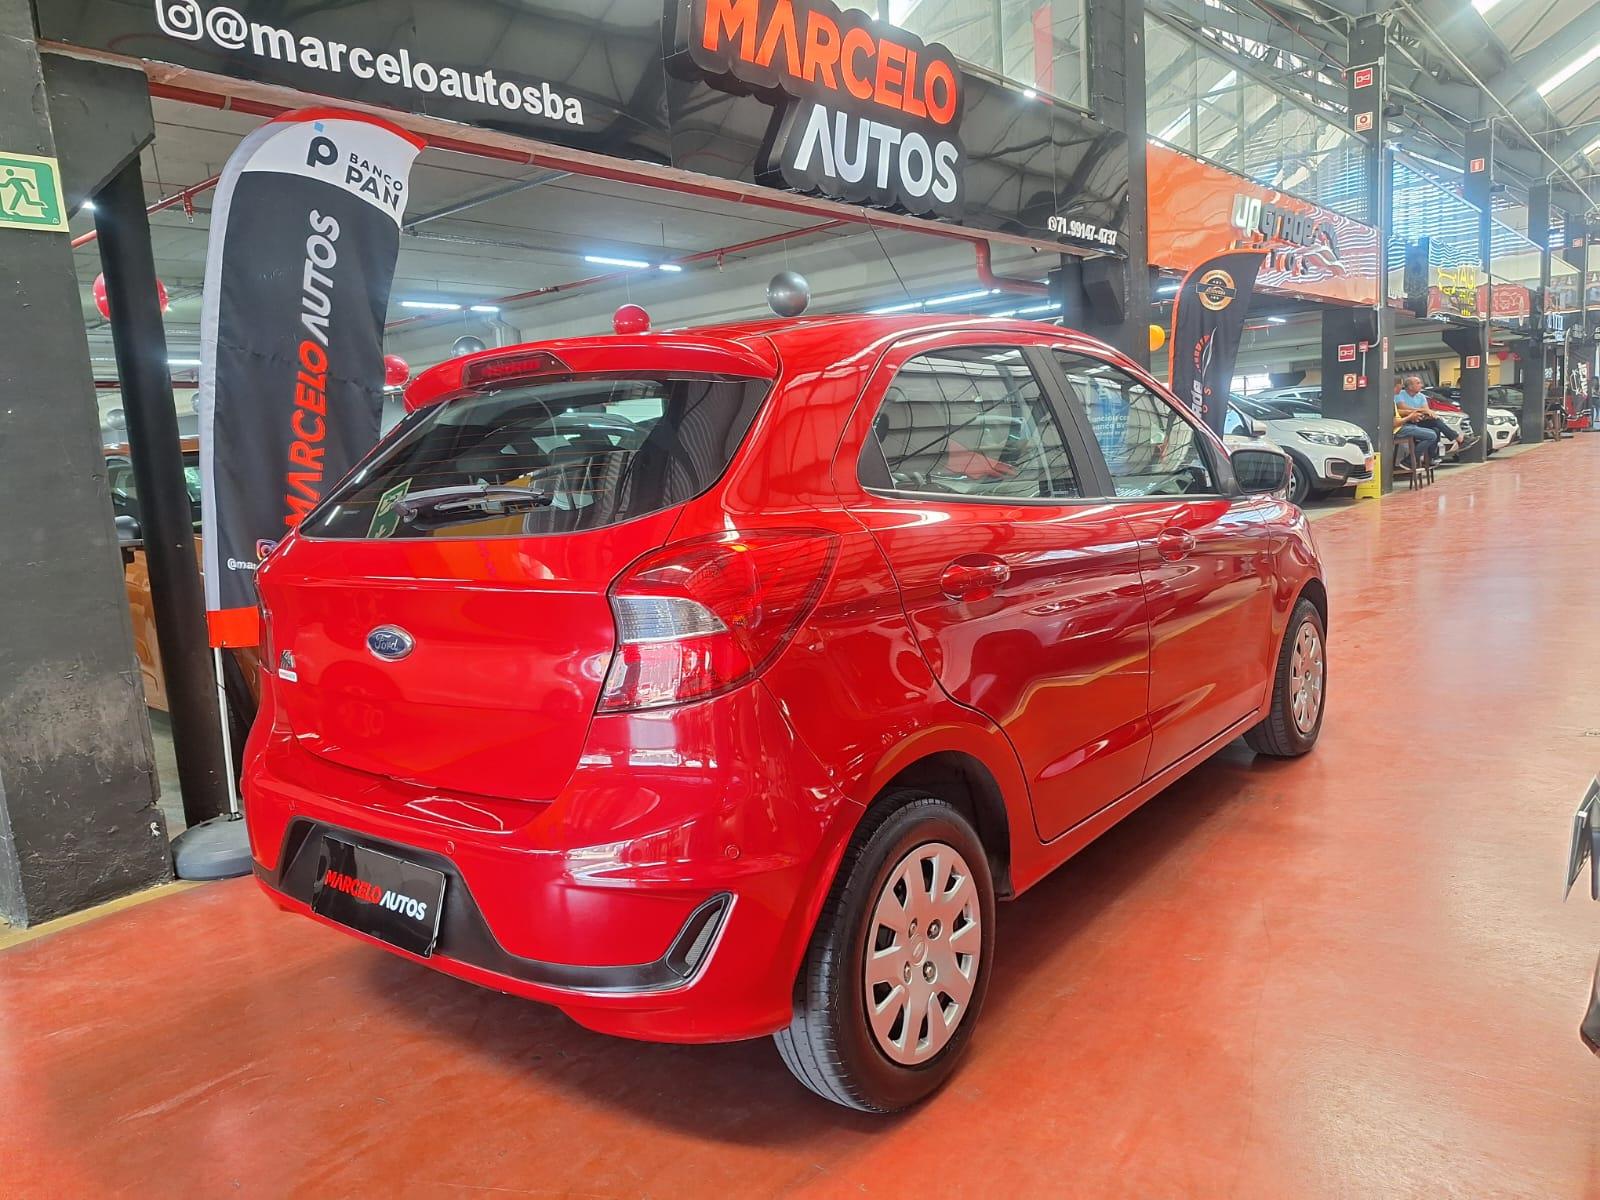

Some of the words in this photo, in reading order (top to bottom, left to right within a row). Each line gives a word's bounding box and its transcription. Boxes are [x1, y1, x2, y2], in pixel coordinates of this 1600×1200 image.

[205, 6, 585, 126] @marceloautosba
[702, 0, 958, 125] MARCELO
[345, 165, 400, 213] PAN
[349, 152, 404, 192] BANCO
[793, 103, 960, 204] AUTOS
[301, 208, 341, 348] AUTOS
[284, 339, 330, 527] MARCELO
[374, 633, 399, 650] Ford
[323, 869, 383, 905] MARCELO
[379, 890, 428, 921] AUTOS
